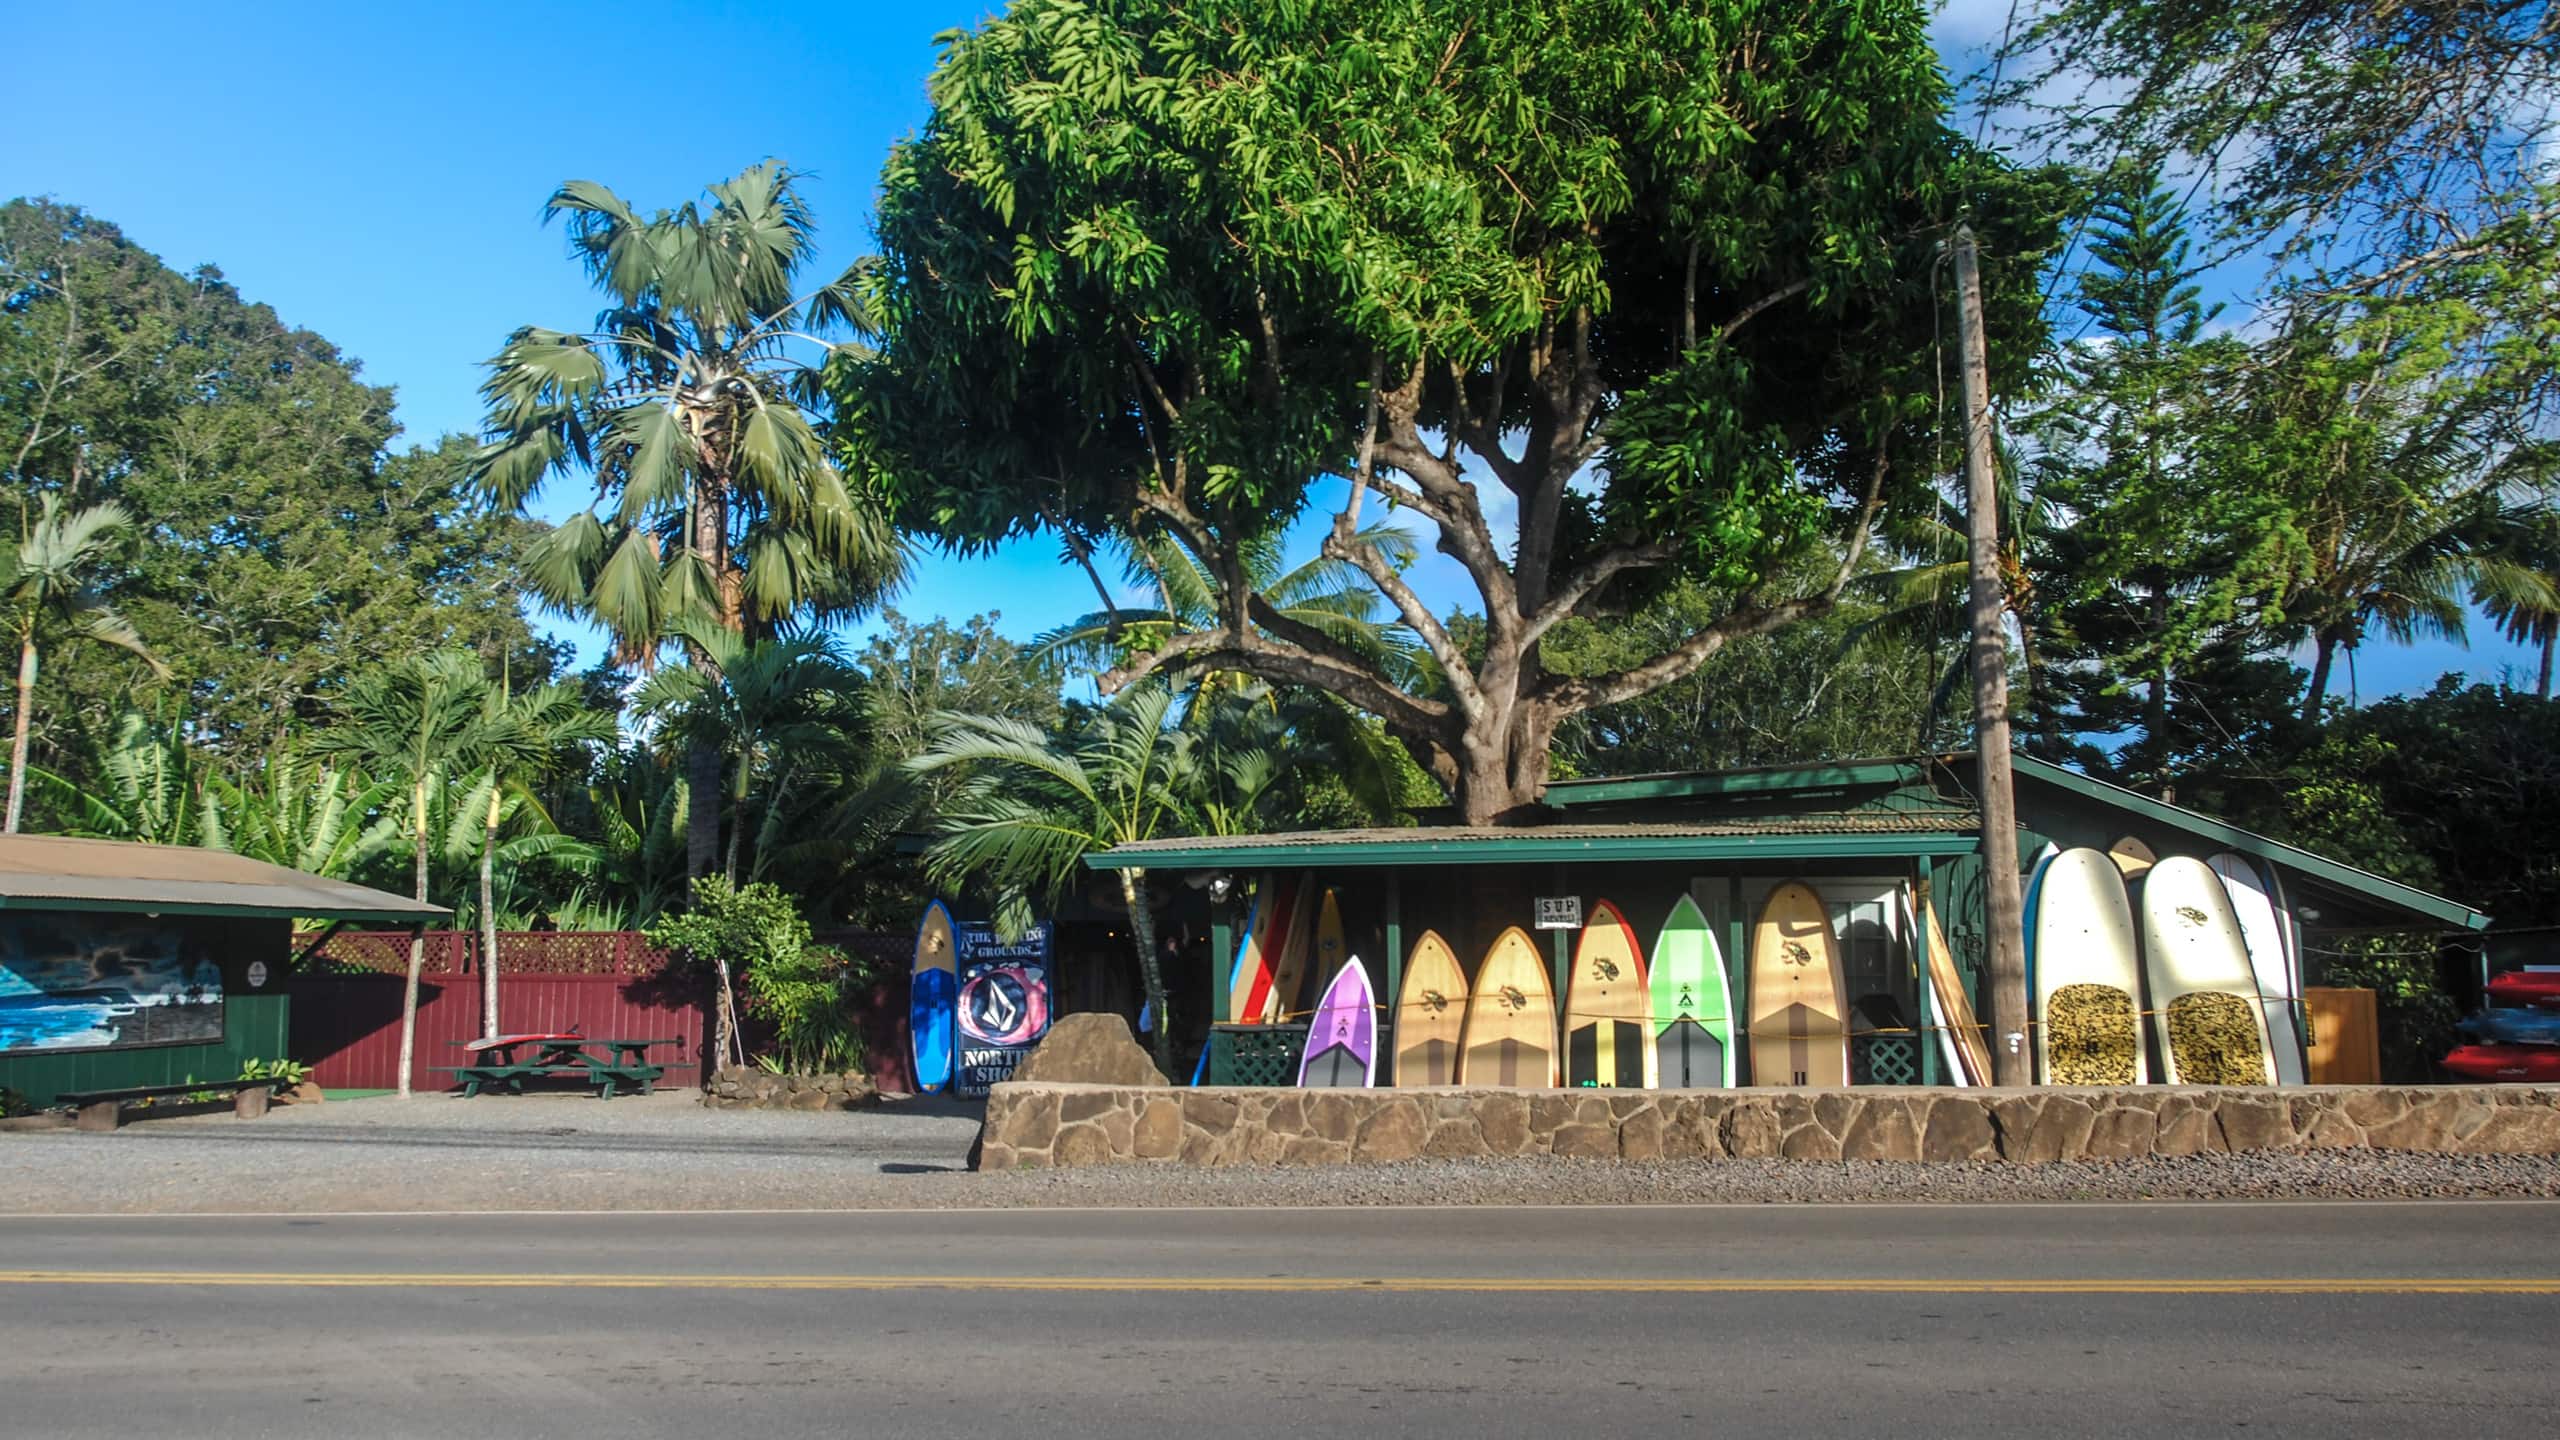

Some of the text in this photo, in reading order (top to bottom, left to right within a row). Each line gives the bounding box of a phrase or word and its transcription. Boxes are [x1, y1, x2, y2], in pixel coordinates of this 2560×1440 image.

[1542, 900, 1574, 912] SUP
[968, 932, 991, 943] THE
[978, 946, 1031, 957] GROUNDS
[976, 1067, 1012, 1082] SHO
